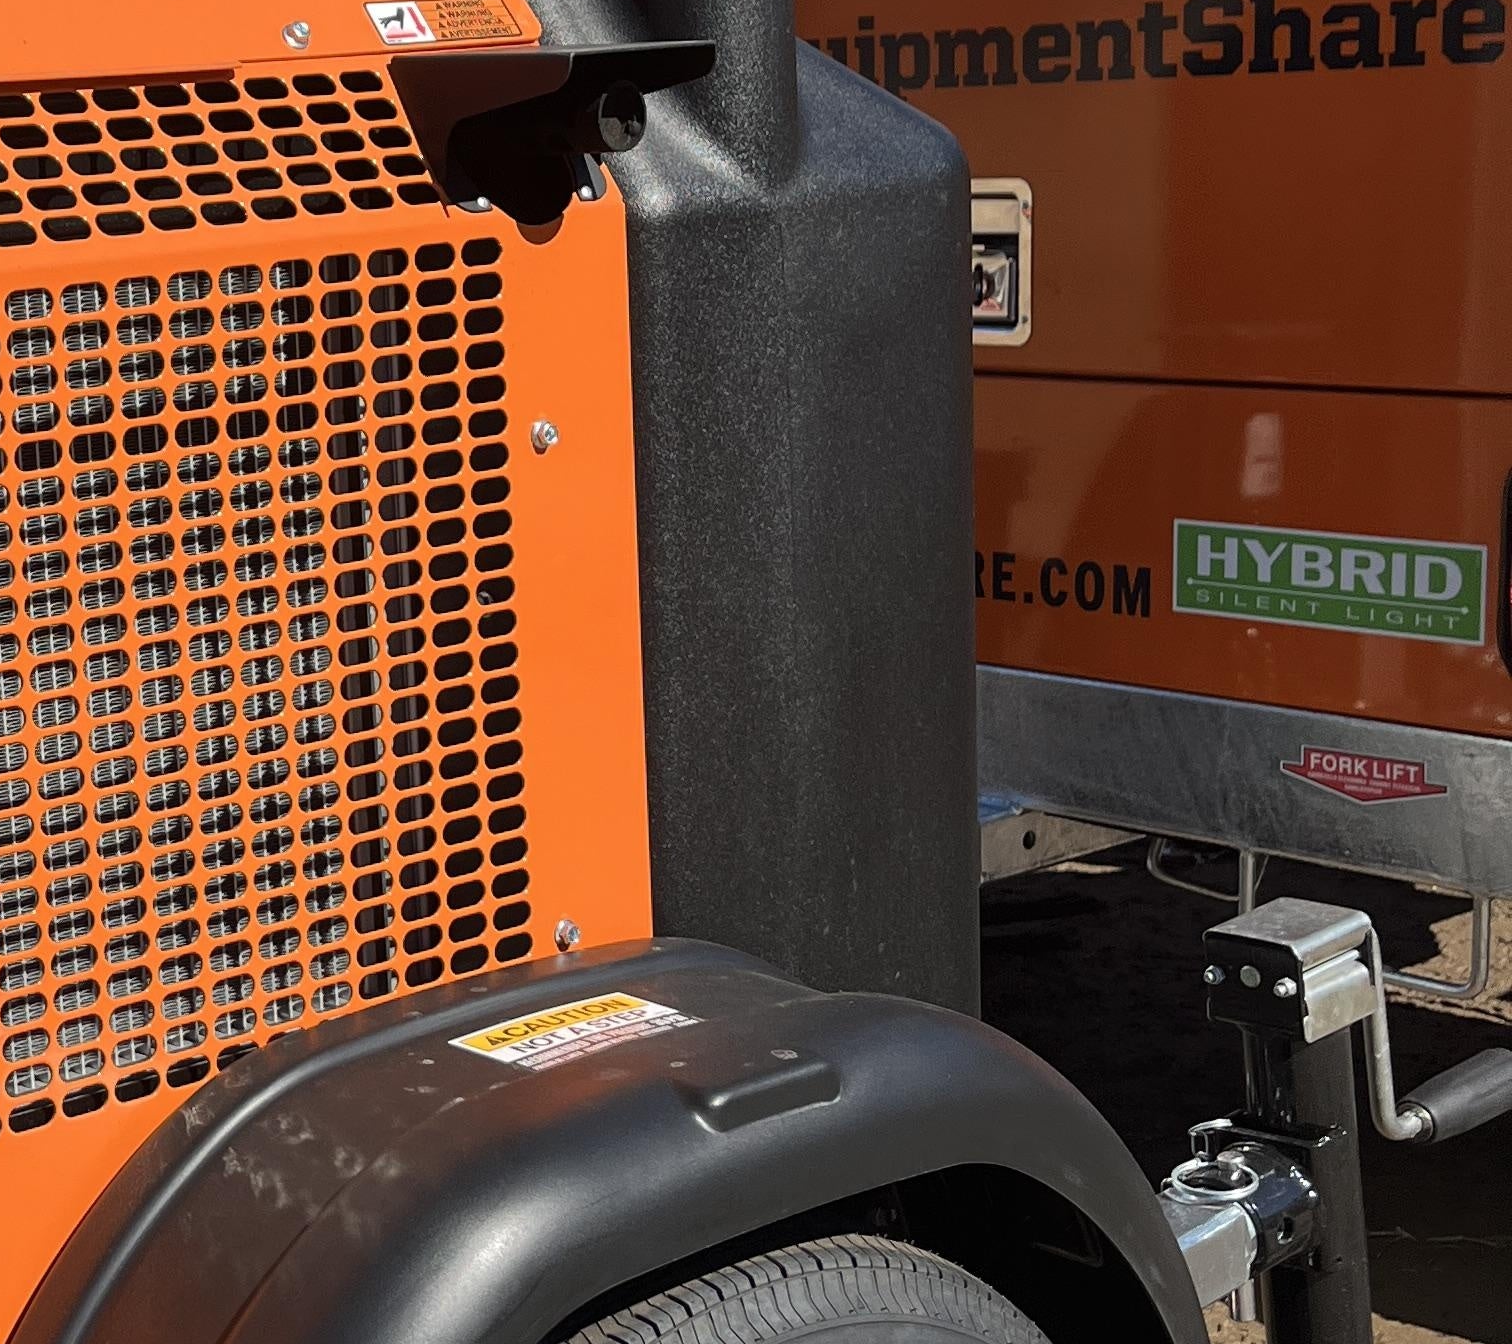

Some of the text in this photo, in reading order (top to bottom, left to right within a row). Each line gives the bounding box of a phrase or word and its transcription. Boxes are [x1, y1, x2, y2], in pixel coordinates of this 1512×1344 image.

[1196, 533, 1463, 601] HYBRID
[1196, 589, 1461, 631] SILENT LIGHT
[1309, 752, 1368, 778] FORK
[1372, 760, 1419, 784] LIFT
[502, 998, 630, 1039] CAUTION
[508, 1008, 649, 1054] NOT A STEP
